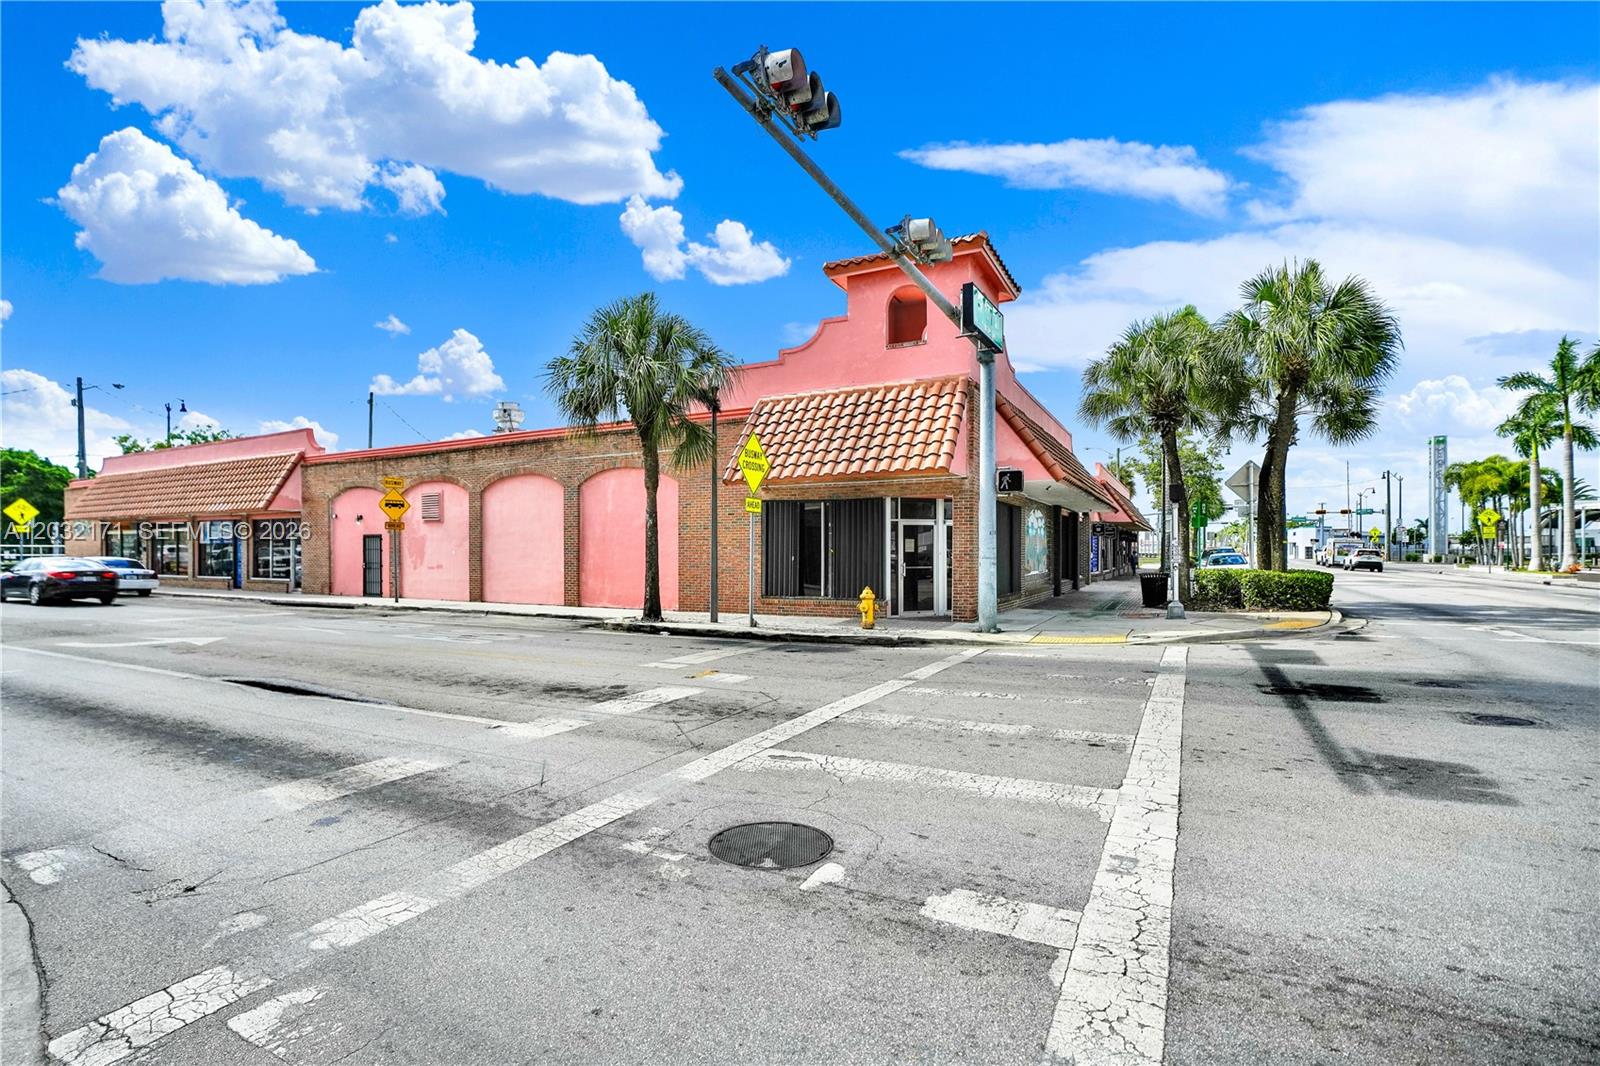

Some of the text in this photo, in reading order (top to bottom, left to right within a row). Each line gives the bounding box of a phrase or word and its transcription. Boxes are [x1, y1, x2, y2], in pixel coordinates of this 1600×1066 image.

[744, 448, 763, 461] BUSWAY
[742, 460, 765, 473] CROSSING
[747, 500, 760, 510] AHEAD
